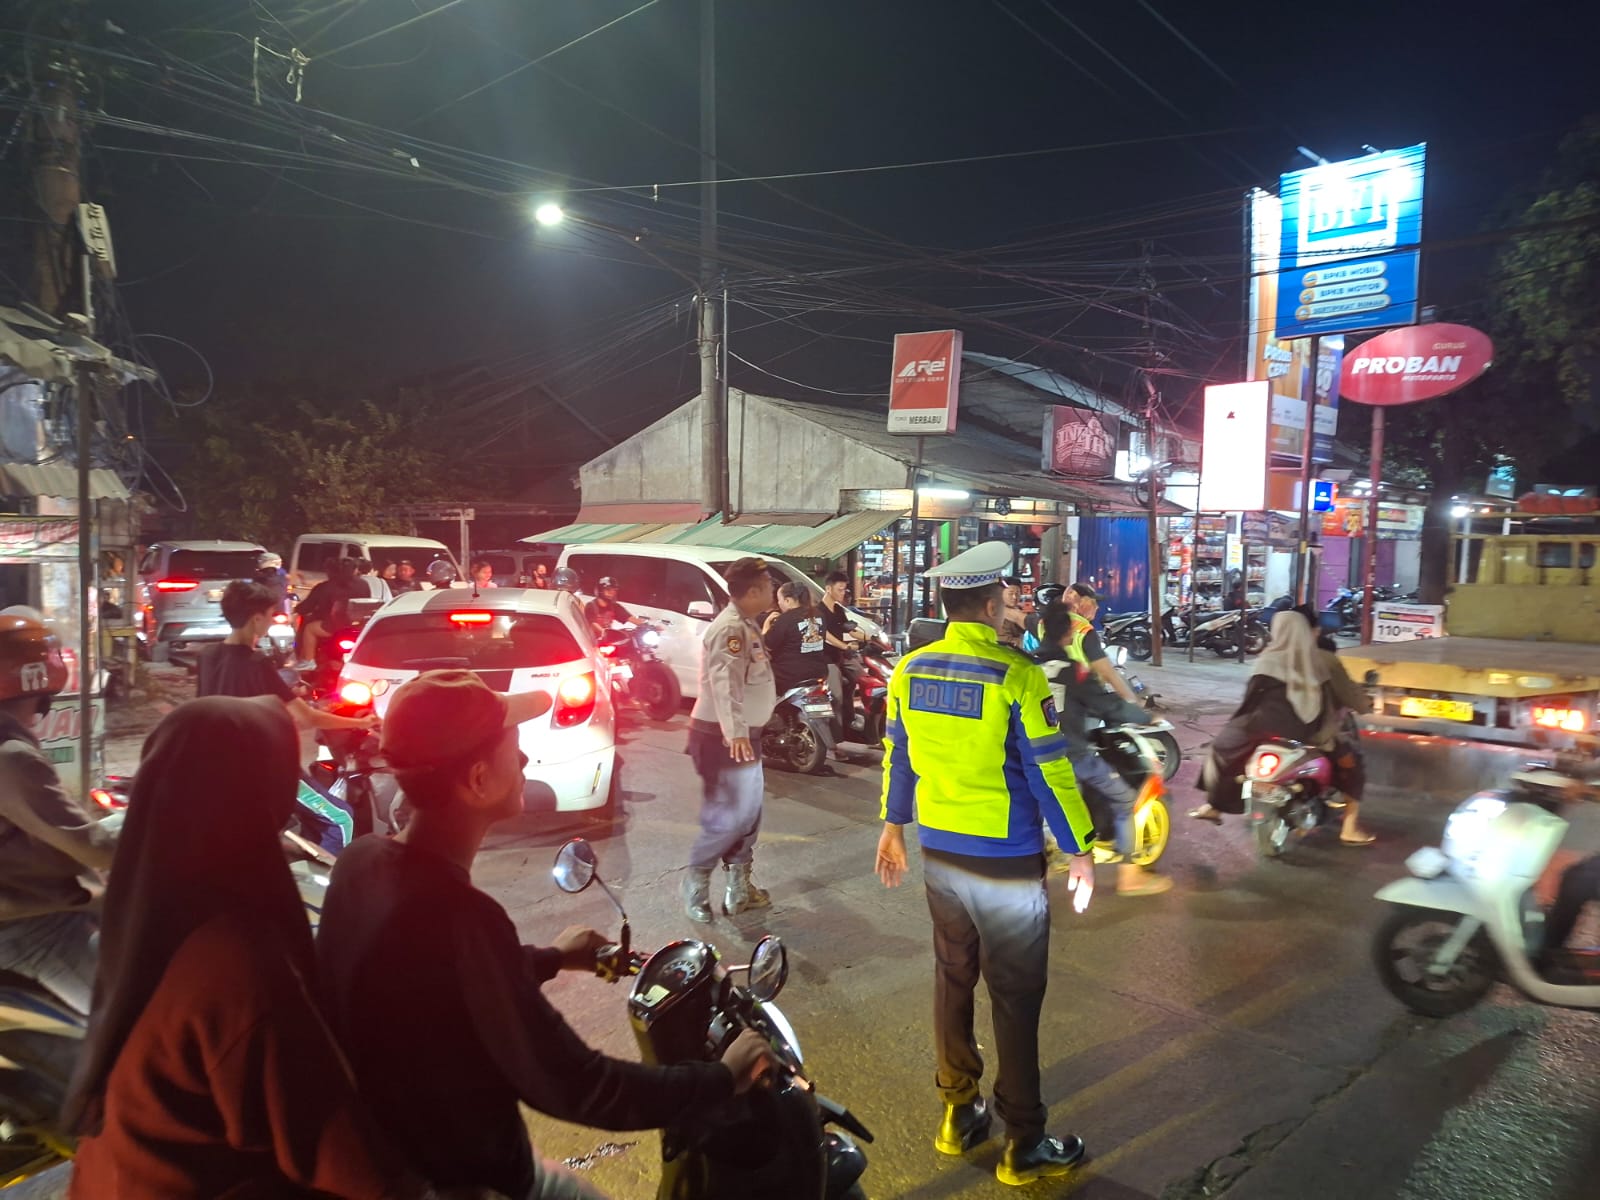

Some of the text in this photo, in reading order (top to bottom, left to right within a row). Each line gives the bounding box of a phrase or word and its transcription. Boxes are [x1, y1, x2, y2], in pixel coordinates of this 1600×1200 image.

[1351, 355, 1463, 374] PROBAN
[909, 416, 942, 425] MERBABU
[1377, 624, 1401, 637] 110
[912, 683, 979, 712] POLISI
